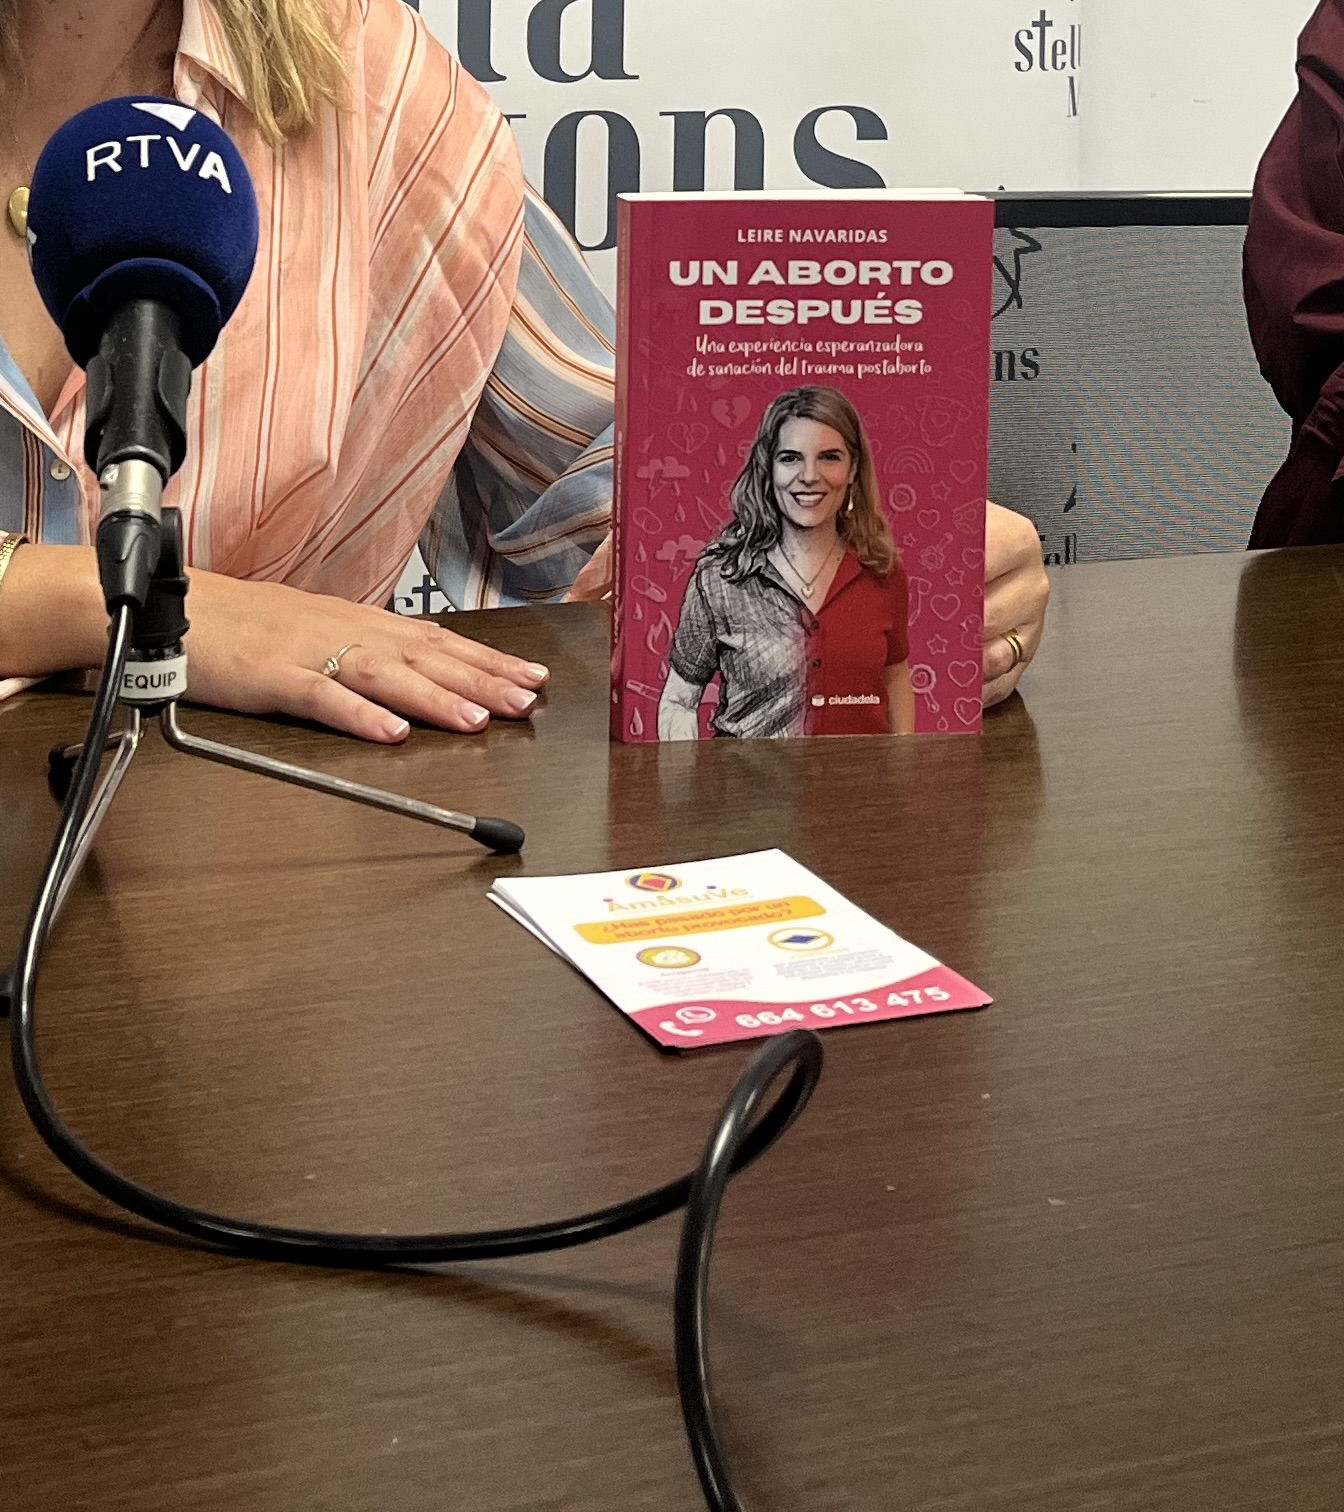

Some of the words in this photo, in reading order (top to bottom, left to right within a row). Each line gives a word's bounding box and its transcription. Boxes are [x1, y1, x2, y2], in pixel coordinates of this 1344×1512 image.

[86, 134, 232, 194] RTVA
[508, 104, 889, 252] ons
[737, 229, 784, 243] LEIRE
[789, 229, 888, 243] NAVARIDAS
[669, 260, 739, 286] UN
[747, 260, 954, 286] ABORTO
[699, 292, 923, 325] DESPUÉS
[695, 333, 725, 354] Una
[729, 336, 812, 357] experiencia
[816, 334, 923, 357] esperanzadora
[687, 358, 705, 377] de
[708, 359, 771, 376] sanación
[775, 357, 797, 375] del
[801, 359, 854, 375] trauma
[858, 356, 932, 379] postaborto
[124, 671, 176, 689] EQUIP
[829, 694, 880, 705] ciudadela
[736, 1008, 804, 1028] 664
[810, 997, 878, 1018] 613
[886, 987, 950, 1007] 475
